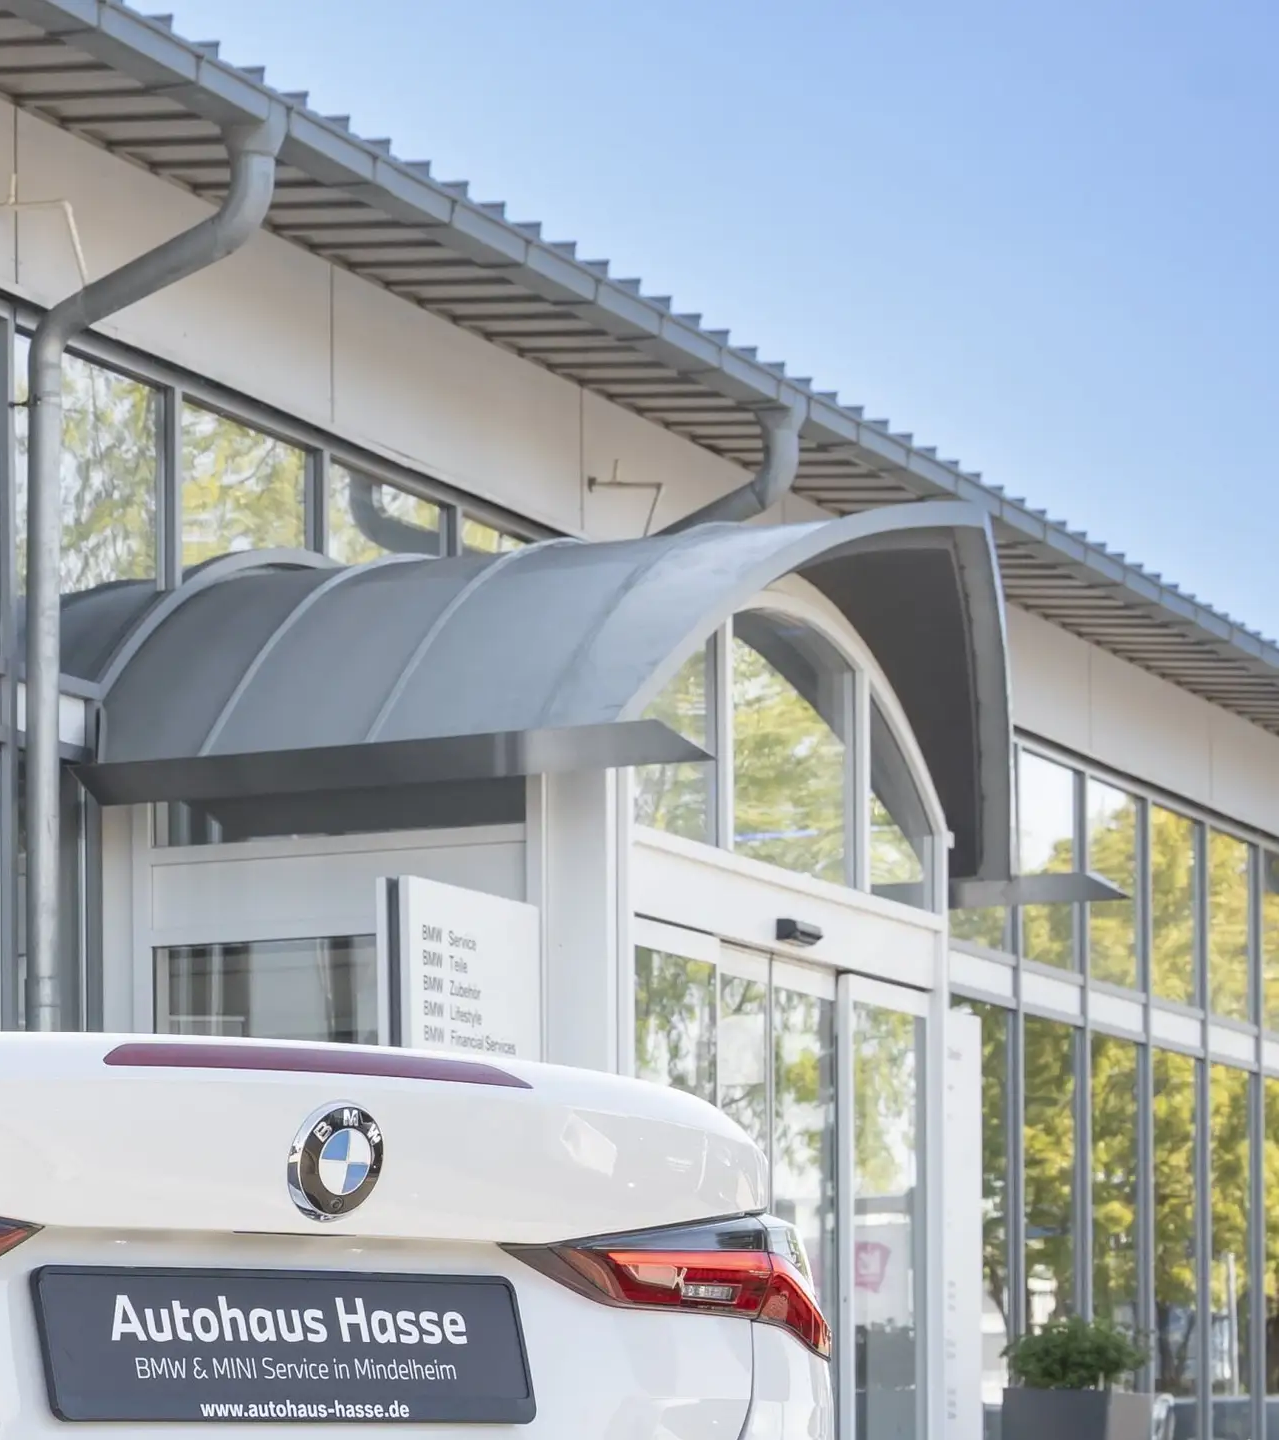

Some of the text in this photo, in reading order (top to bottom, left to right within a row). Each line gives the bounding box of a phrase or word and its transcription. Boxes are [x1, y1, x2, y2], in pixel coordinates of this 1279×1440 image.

[422, 924, 477, 951] BMW Service
[422, 949, 468, 974] BMW Teile
[423, 974, 444, 993] BMW
[423, 999, 482, 1028] BMW Lifestyle
[424, 1024, 517, 1056] BMW Financial Services
[313, 1108, 382, 1145] BMW
[111, 1294, 468, 1345] Autohaus Hasse
[135, 1356, 457, 1380] BMW & MINI Service in Mindelheim
[200, 1400, 410, 1418] www.autohaus-hasse.de
